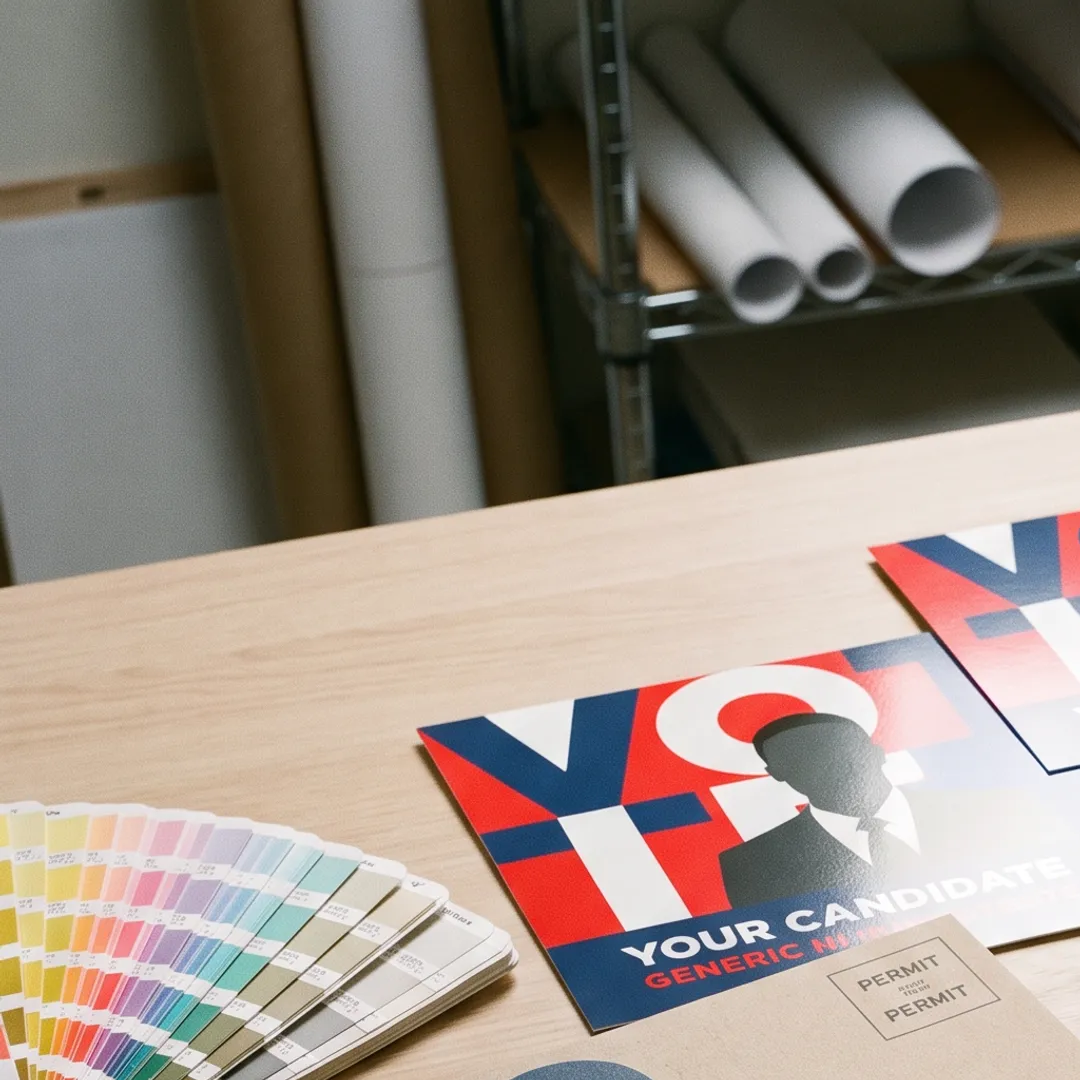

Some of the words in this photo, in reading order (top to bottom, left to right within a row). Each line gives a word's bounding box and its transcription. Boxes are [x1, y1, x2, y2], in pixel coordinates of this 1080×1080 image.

[620, 919, 777, 967] YOUR
[784, 855, 1075, 933] CANDIDATE
[643, 942, 805, 990] GENERIC
[856, 954, 941, 992] PERMIT
[883, 984, 968, 1023] PERMIT
